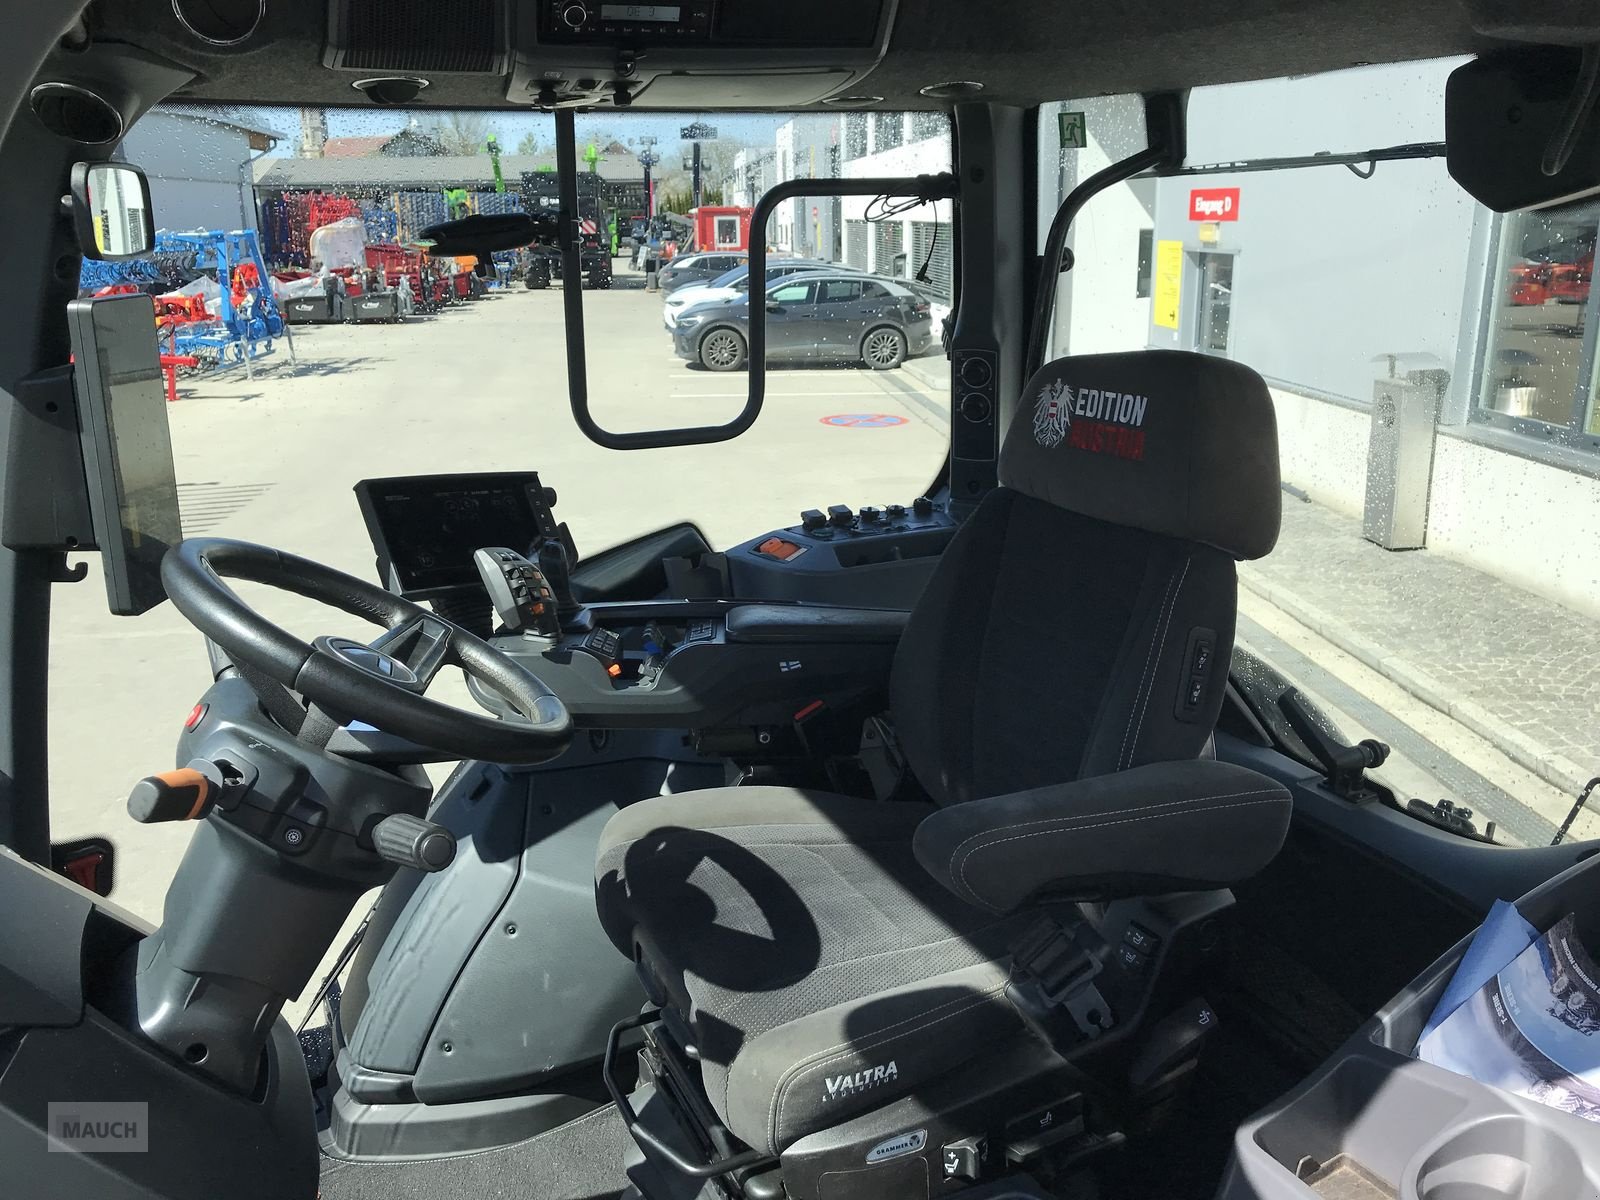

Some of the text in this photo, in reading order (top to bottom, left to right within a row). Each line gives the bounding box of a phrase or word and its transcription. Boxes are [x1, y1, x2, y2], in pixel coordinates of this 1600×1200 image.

[1224, 196, 1232, 212] D
[1074, 387, 1148, 427] EDITION
[1069, 418, 1146, 461] AUSTRIA
[1492, 992, 1508, 1025] T-SERIE
[824, 1060, 898, 1095] VALTRA
[876, 1142, 909, 1155] GRAMMER
